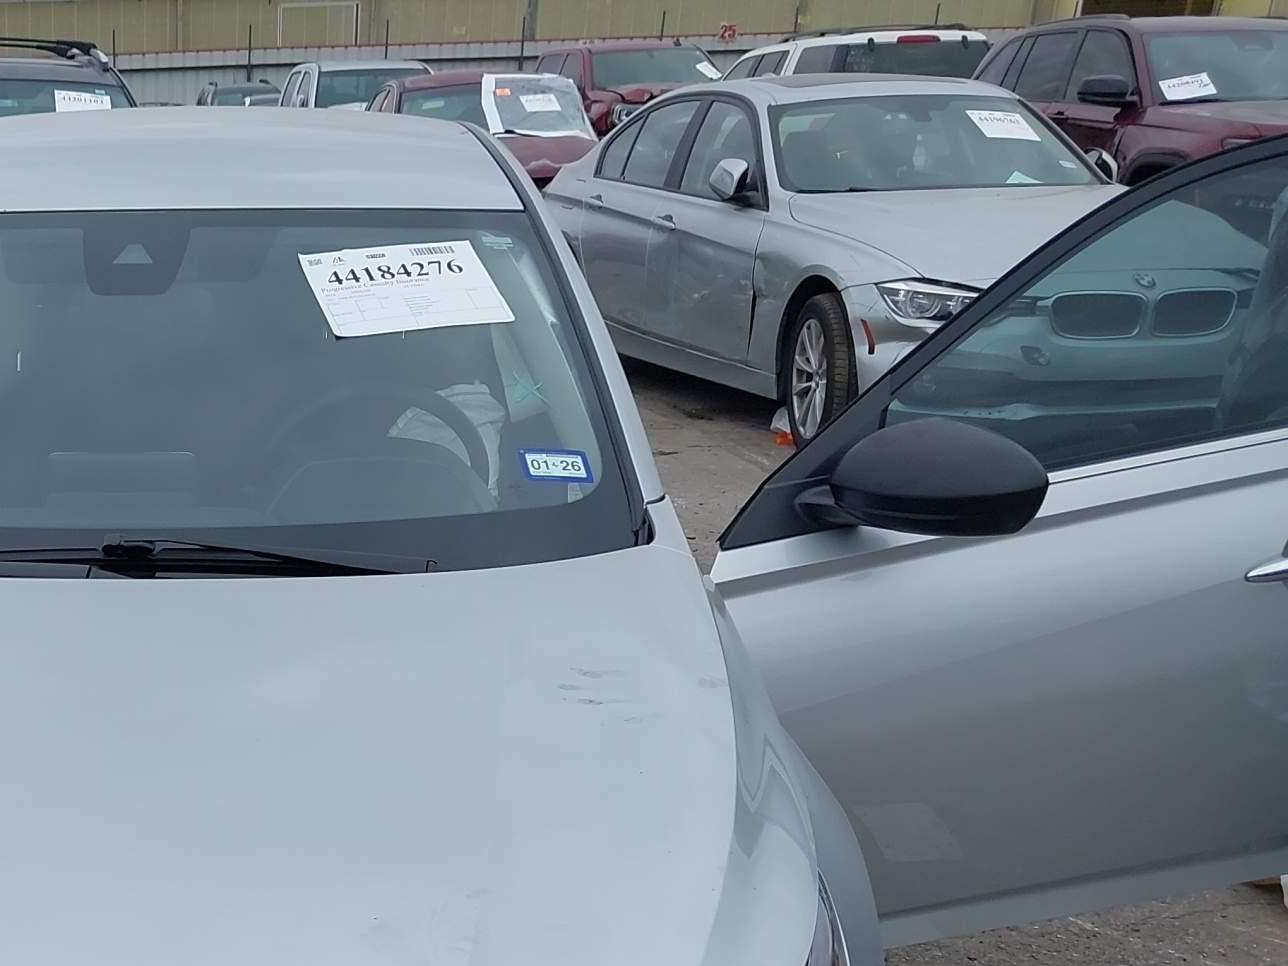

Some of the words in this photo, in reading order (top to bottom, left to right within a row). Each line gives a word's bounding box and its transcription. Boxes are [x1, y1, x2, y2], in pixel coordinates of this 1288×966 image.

[719, 23, 737, 40] 25
[327, 258, 464, 285] 44184276
[531, 459, 550, 471] 01
[560, 460, 582, 471] 26
